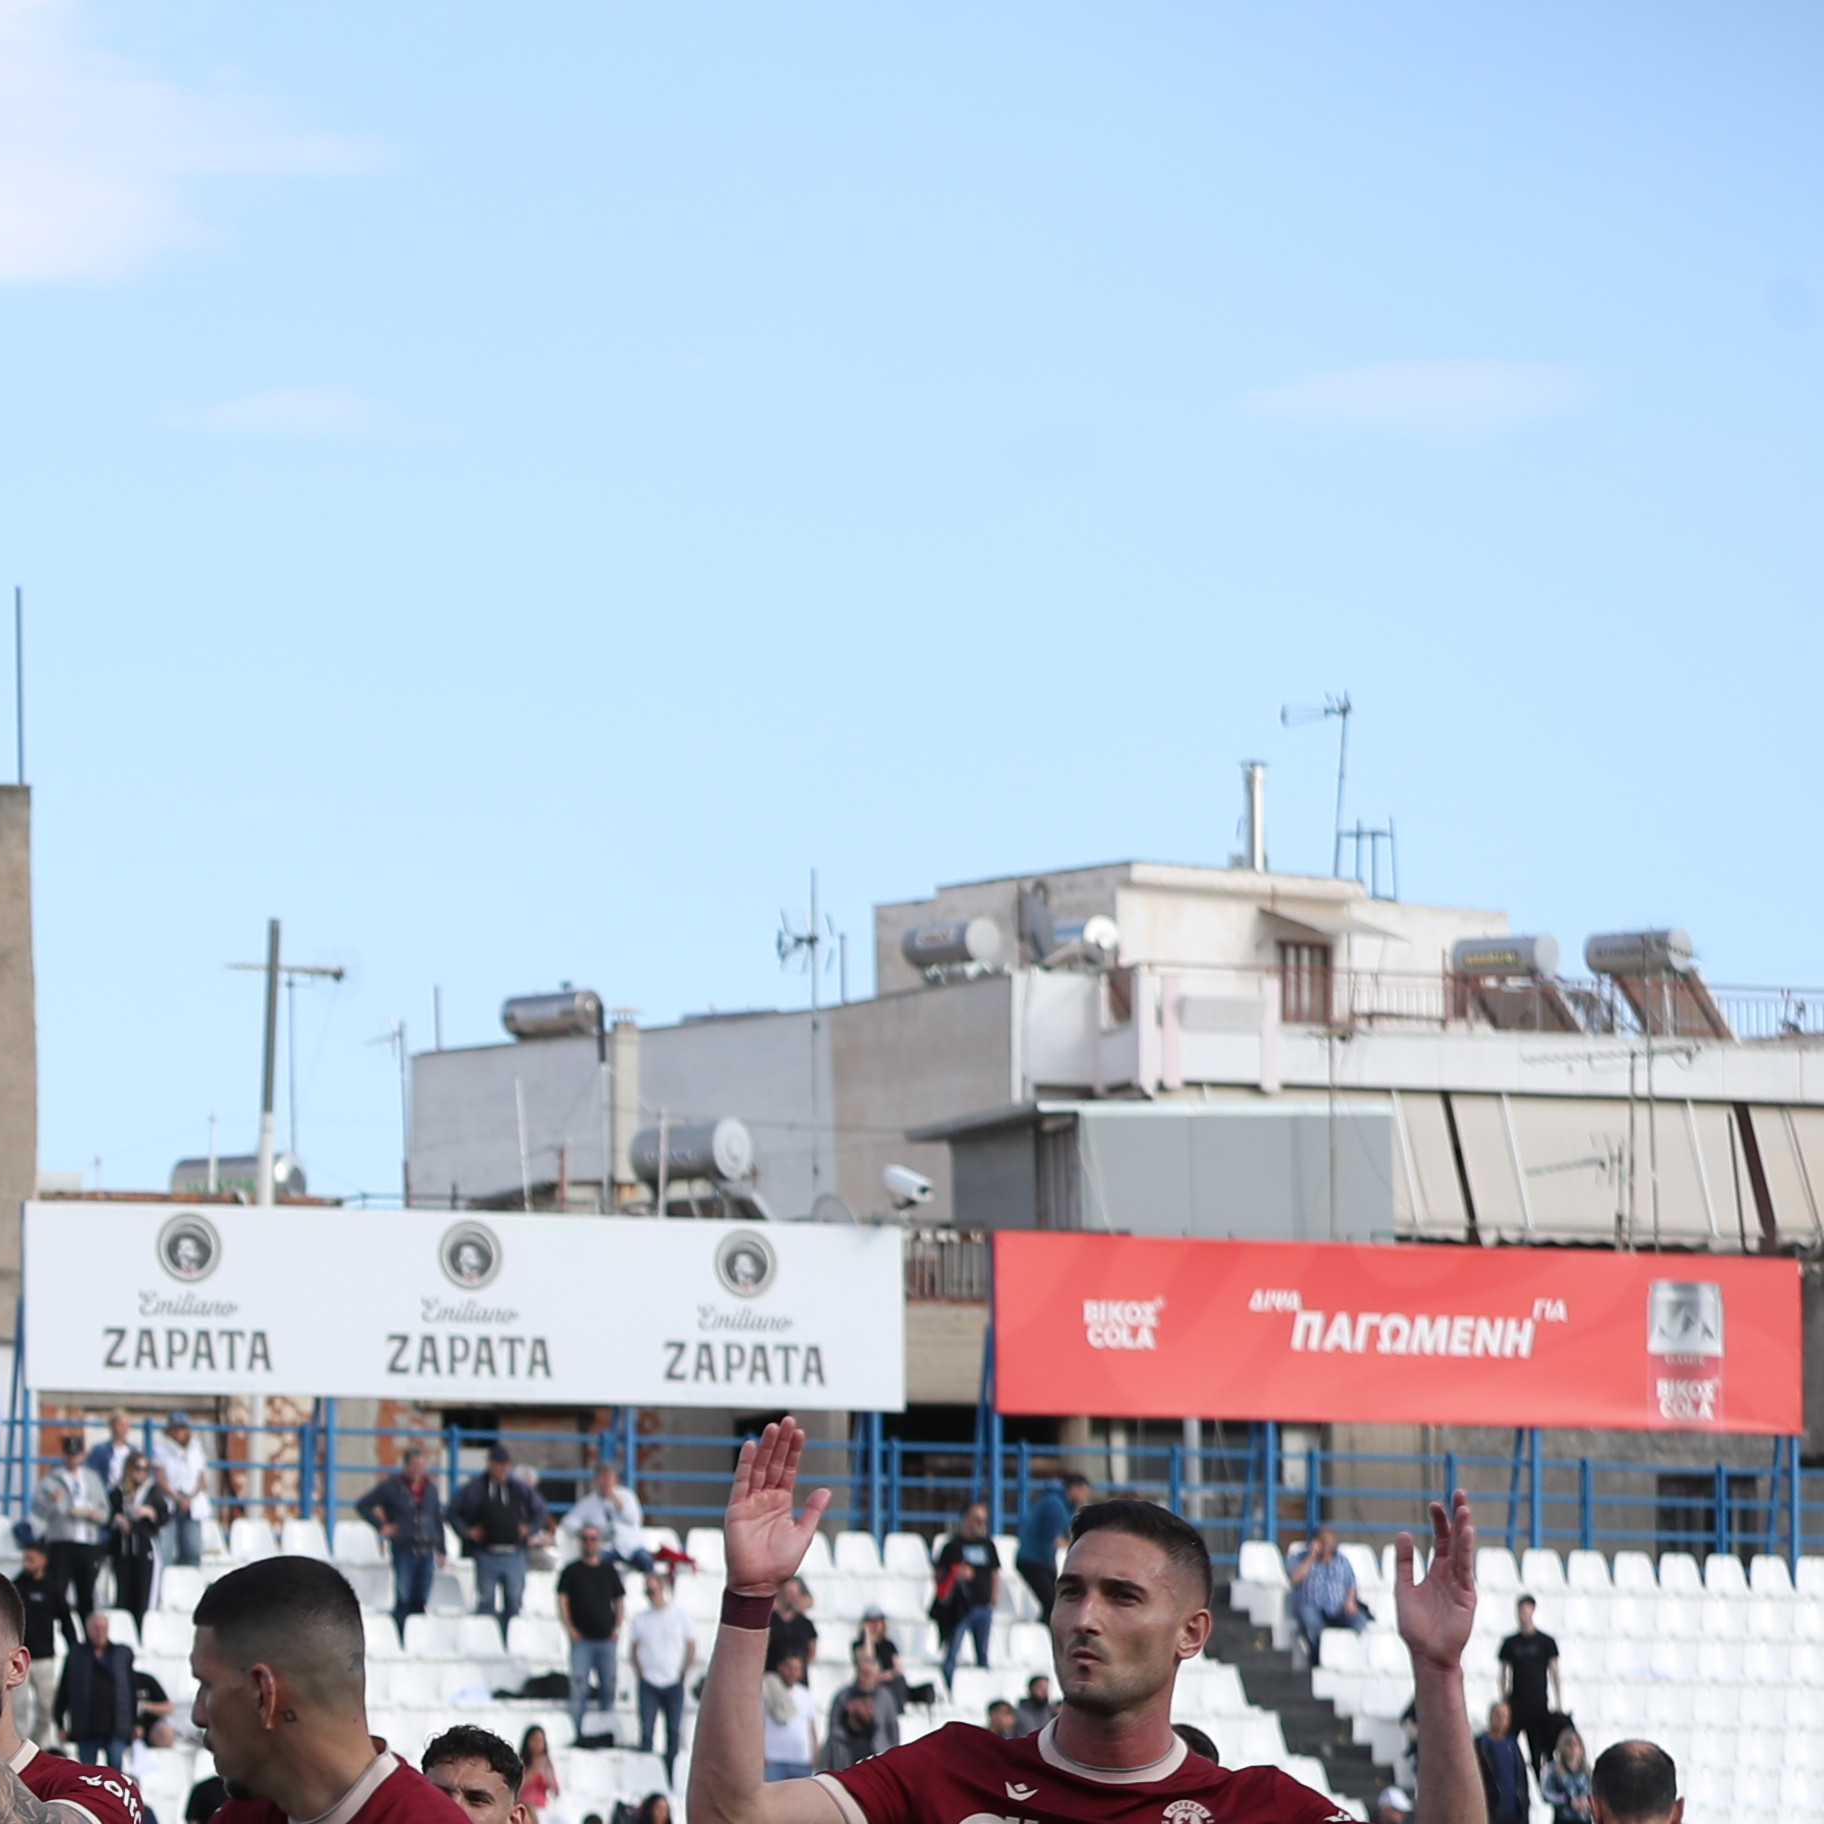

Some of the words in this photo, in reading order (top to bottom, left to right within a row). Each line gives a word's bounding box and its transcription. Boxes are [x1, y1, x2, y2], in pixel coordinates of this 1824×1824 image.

[137, 1288, 239, 1318] Emiliano
[420, 1296, 519, 1325] Emiliano
[697, 1303, 794, 1333] Emiliano
[103, 1326, 273, 1372] ZAPATA
[386, 1333, 554, 1379] ZAPATA
[1290, 1311, 1536, 1358] ΠΑΓΩΜΕΝΗ
[663, 1340, 827, 1387] ZAPATA
